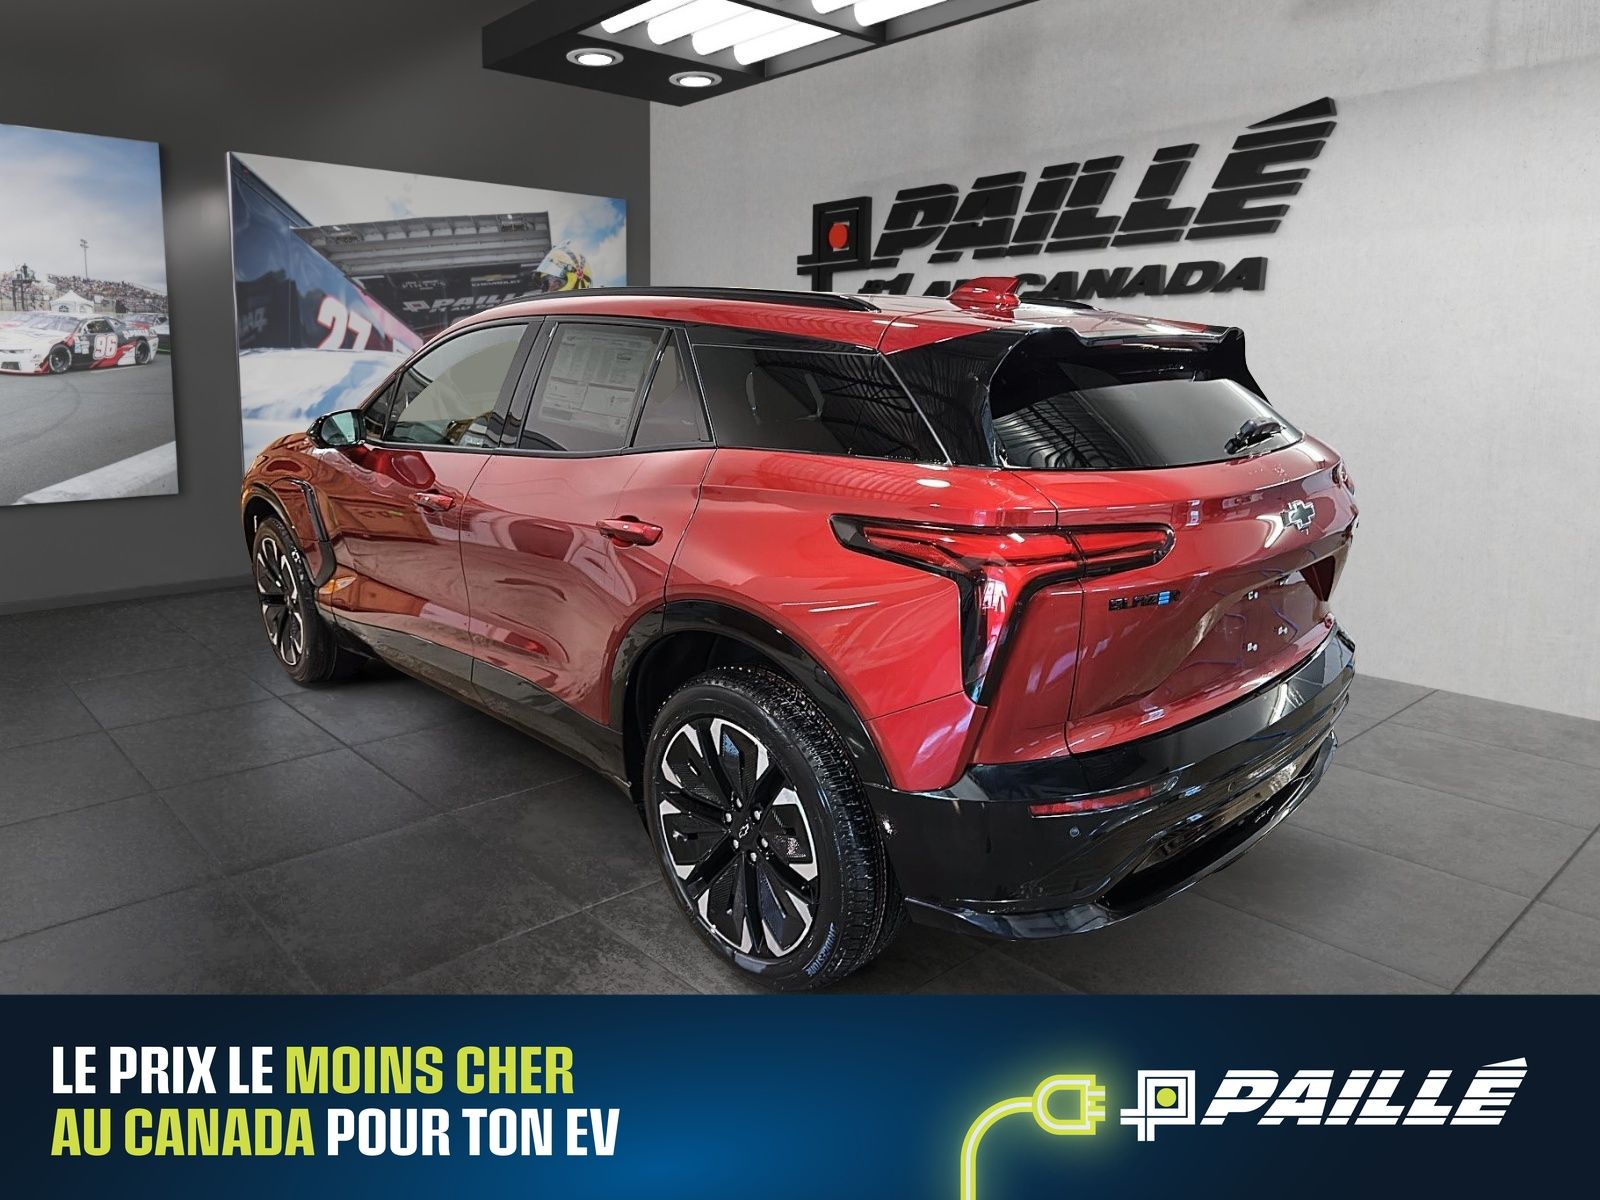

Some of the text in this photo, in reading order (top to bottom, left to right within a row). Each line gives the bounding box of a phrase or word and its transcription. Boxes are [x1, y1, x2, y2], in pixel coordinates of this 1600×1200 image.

[869, 97, 1337, 268] PAILLÉ
[1016, 256, 1269, 300] CANADA
[93, 333, 118, 360] 96
[317, 296, 372, 350] 27
